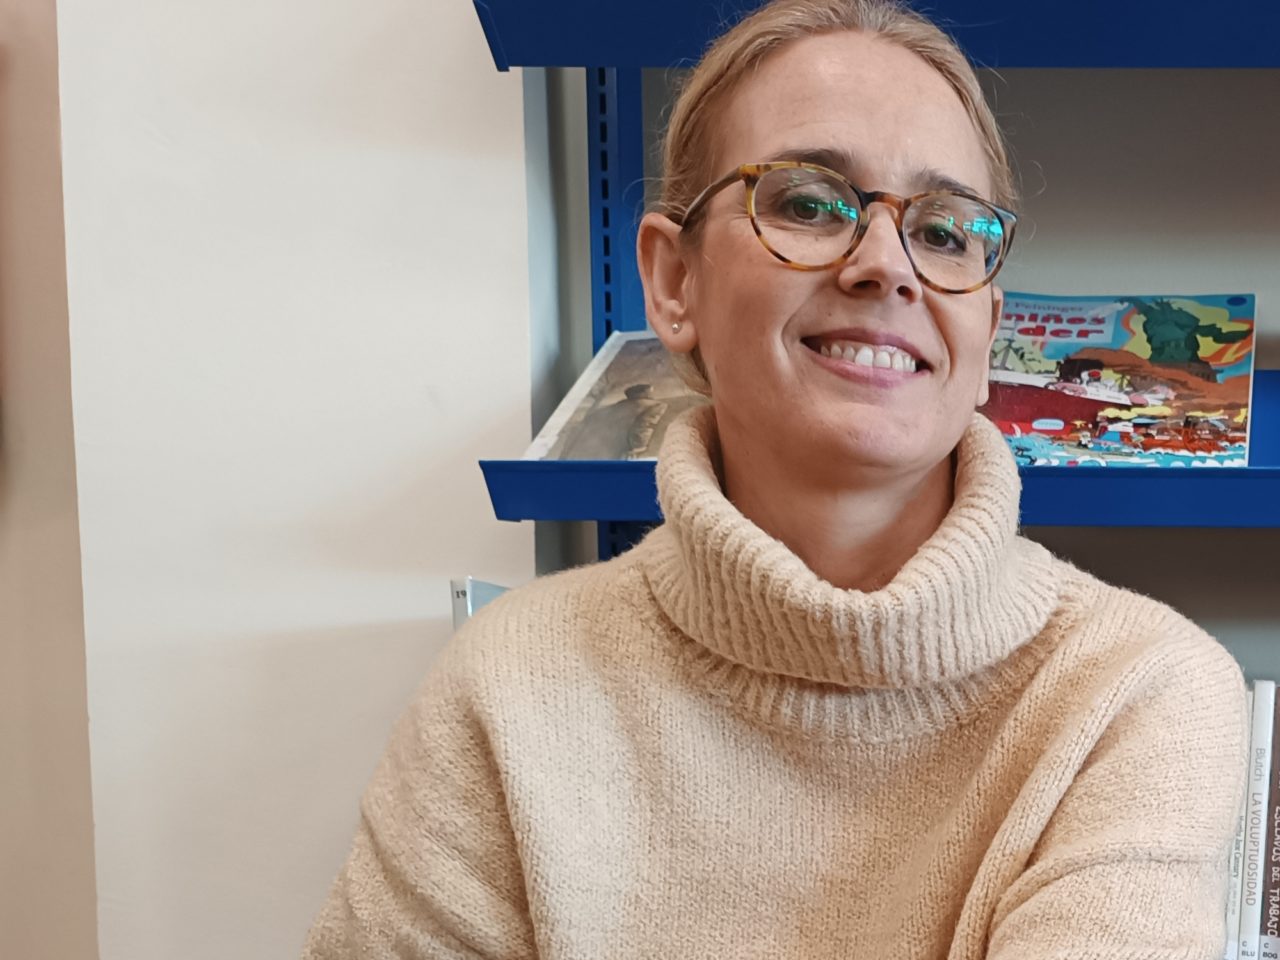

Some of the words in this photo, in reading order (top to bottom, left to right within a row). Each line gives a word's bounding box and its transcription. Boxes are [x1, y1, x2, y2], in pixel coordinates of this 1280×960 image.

[1245, 808, 1261, 907] VOLUPTUOSIDAD
[1271, 866, 1280, 883] DEL
[1267, 887, 1280, 938] TRABAJO
